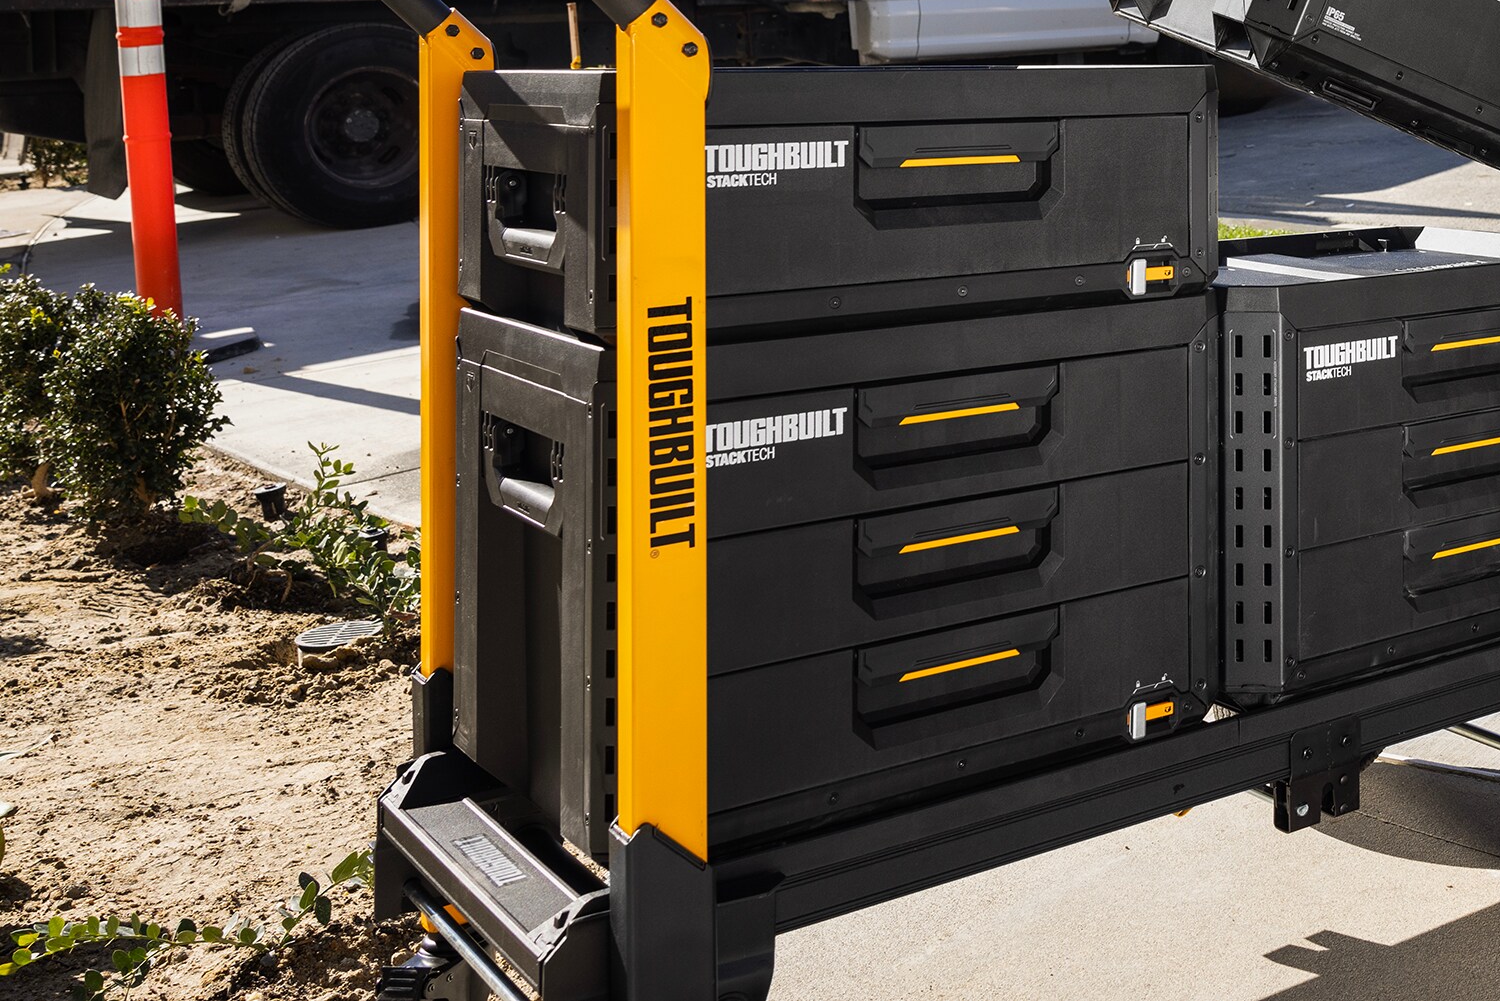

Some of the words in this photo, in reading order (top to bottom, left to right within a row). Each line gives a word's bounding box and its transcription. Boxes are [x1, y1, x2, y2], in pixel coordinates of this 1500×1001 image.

[1326, 5, 1346, 22] IP65
[705, 140, 849, 173] TOUGHBUILT
[706, 172, 778, 189] STACKTECH
[1303, 335, 1399, 370] TOUGHBUILT
[1305, 365, 1352, 382] STACKTECH
[647, 296, 696, 549] TOUGHBUILT
[706, 406, 848, 453] TOUGHBUILT
[706, 446, 776, 468] STACKTECH
